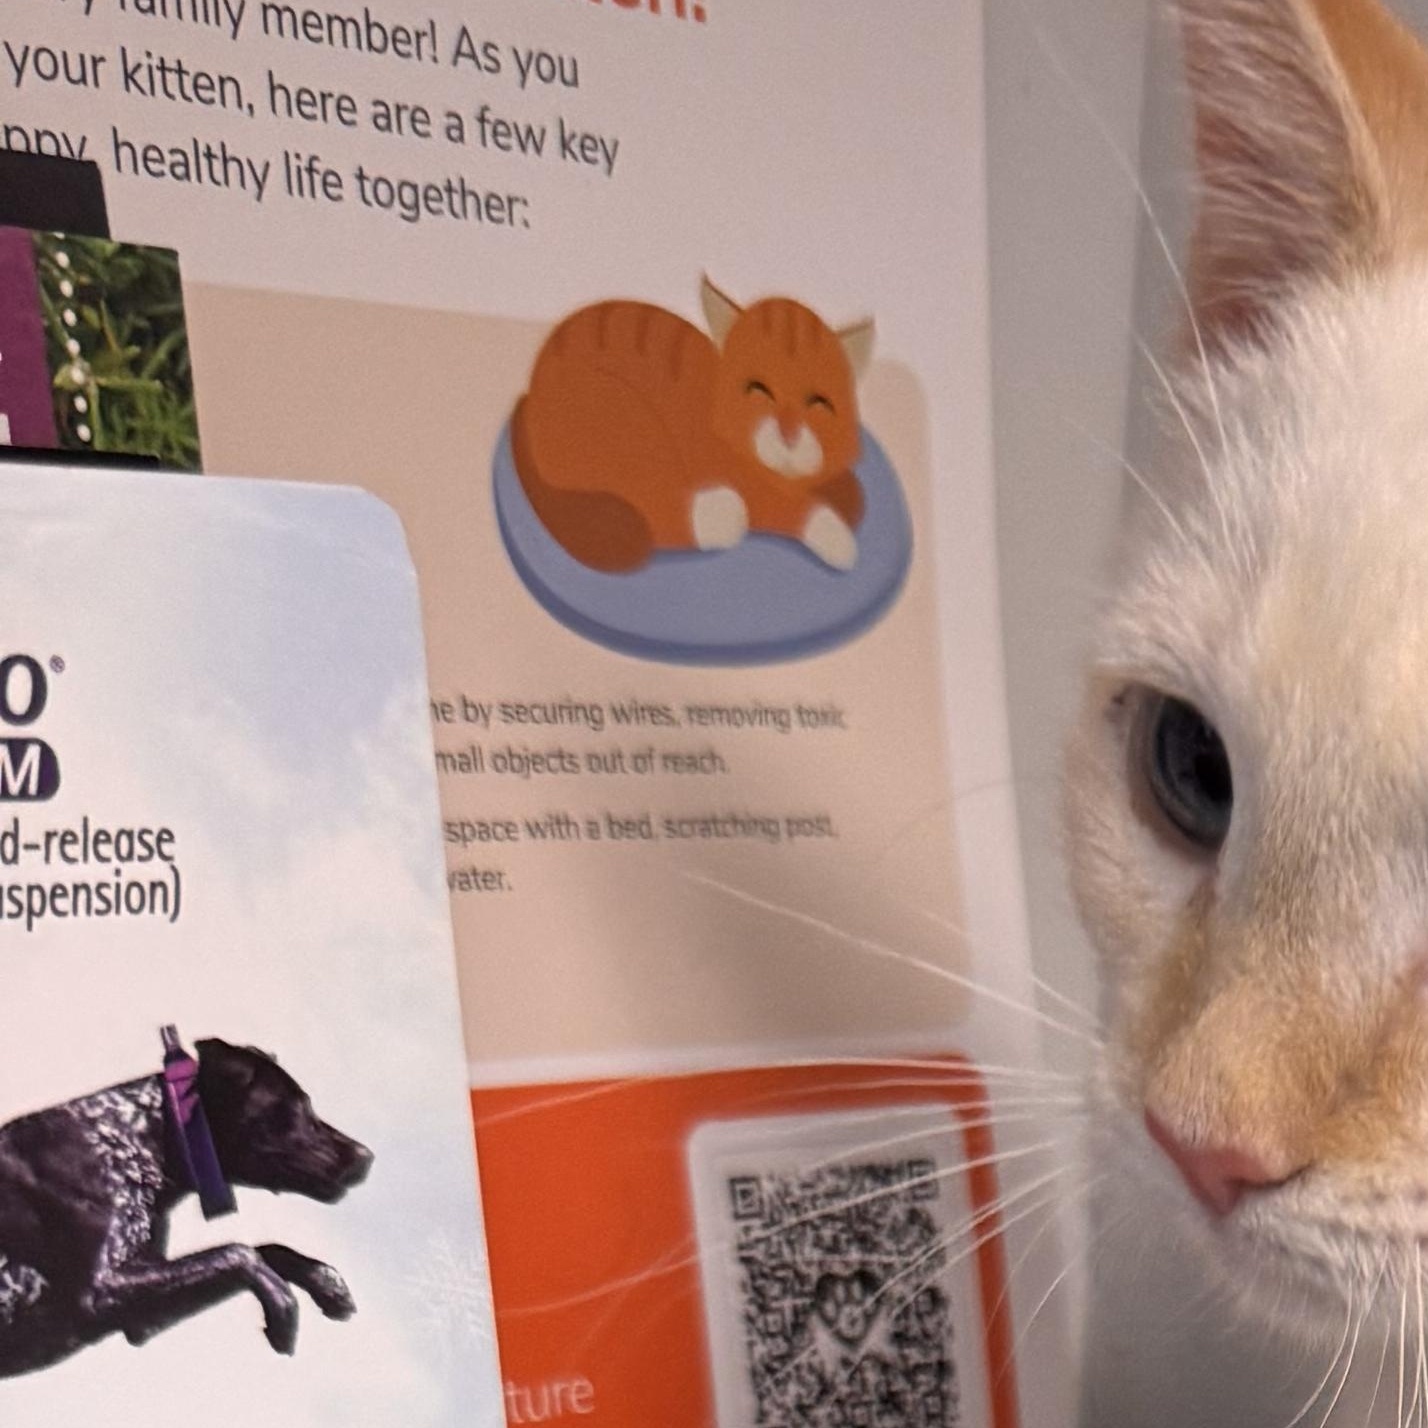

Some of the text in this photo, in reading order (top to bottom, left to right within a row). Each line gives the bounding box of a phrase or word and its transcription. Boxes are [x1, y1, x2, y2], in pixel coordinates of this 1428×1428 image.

[260, 2, 438, 63] member!
[452, 26, 501, 73] As
[512, 46, 580, 89] you
[3, 41, 620, 177] your kitten, here are a few key
[112, 125, 270, 203] healthy
[283, 150, 343, 201] life
[354, 164, 531, 229] together:
[461, 694, 493, 730] by
[499, 696, 604, 732] securing
[685, 699, 791, 734] removing
[492, 746, 581, 779] objects
[587, 749, 628, 775] out
[632, 747, 656, 774] of
[444, 819, 520, 848] space
[525, 812, 582, 841] with
[587, 819, 600, 841] a
[664, 813, 781, 845] scratching
